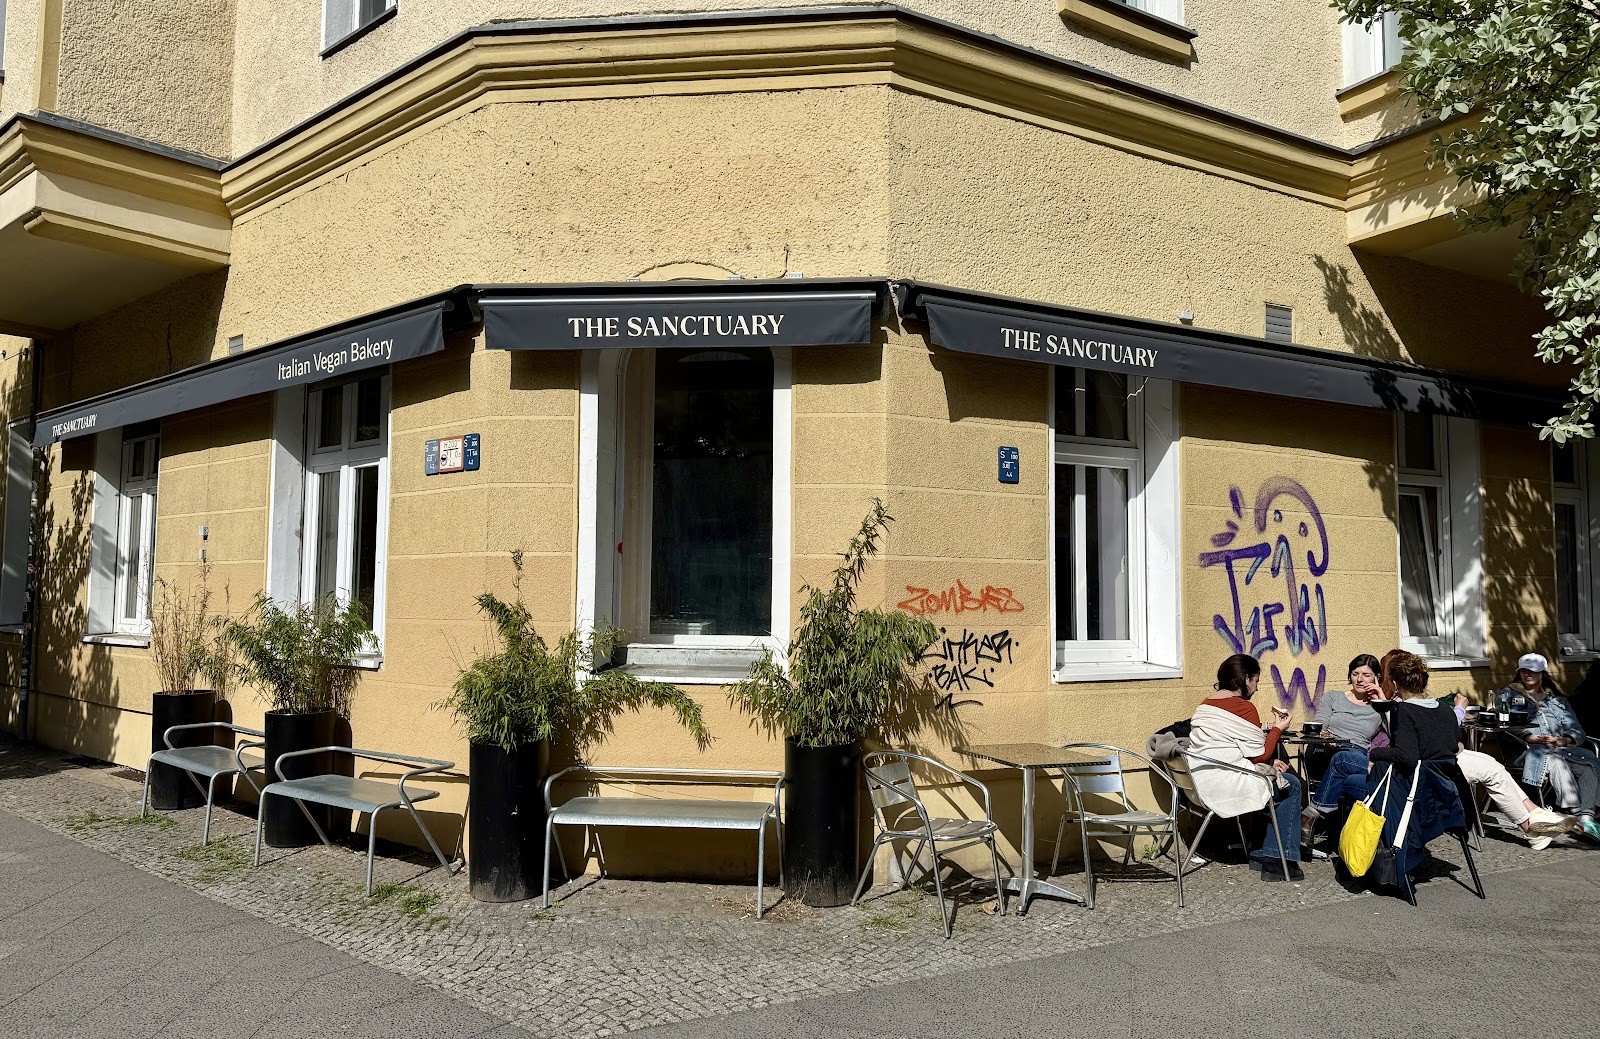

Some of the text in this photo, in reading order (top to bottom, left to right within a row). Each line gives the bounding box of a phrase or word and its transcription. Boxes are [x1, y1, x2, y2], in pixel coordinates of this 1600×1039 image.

[567, 314, 785, 338] THE SANCTUARY
[278, 337, 393, 381] Italian Vegan Bakery
[1000, 327, 1158, 368] THE SANCTUARY
[52, 413, 97, 437] THE SANCTUARY
